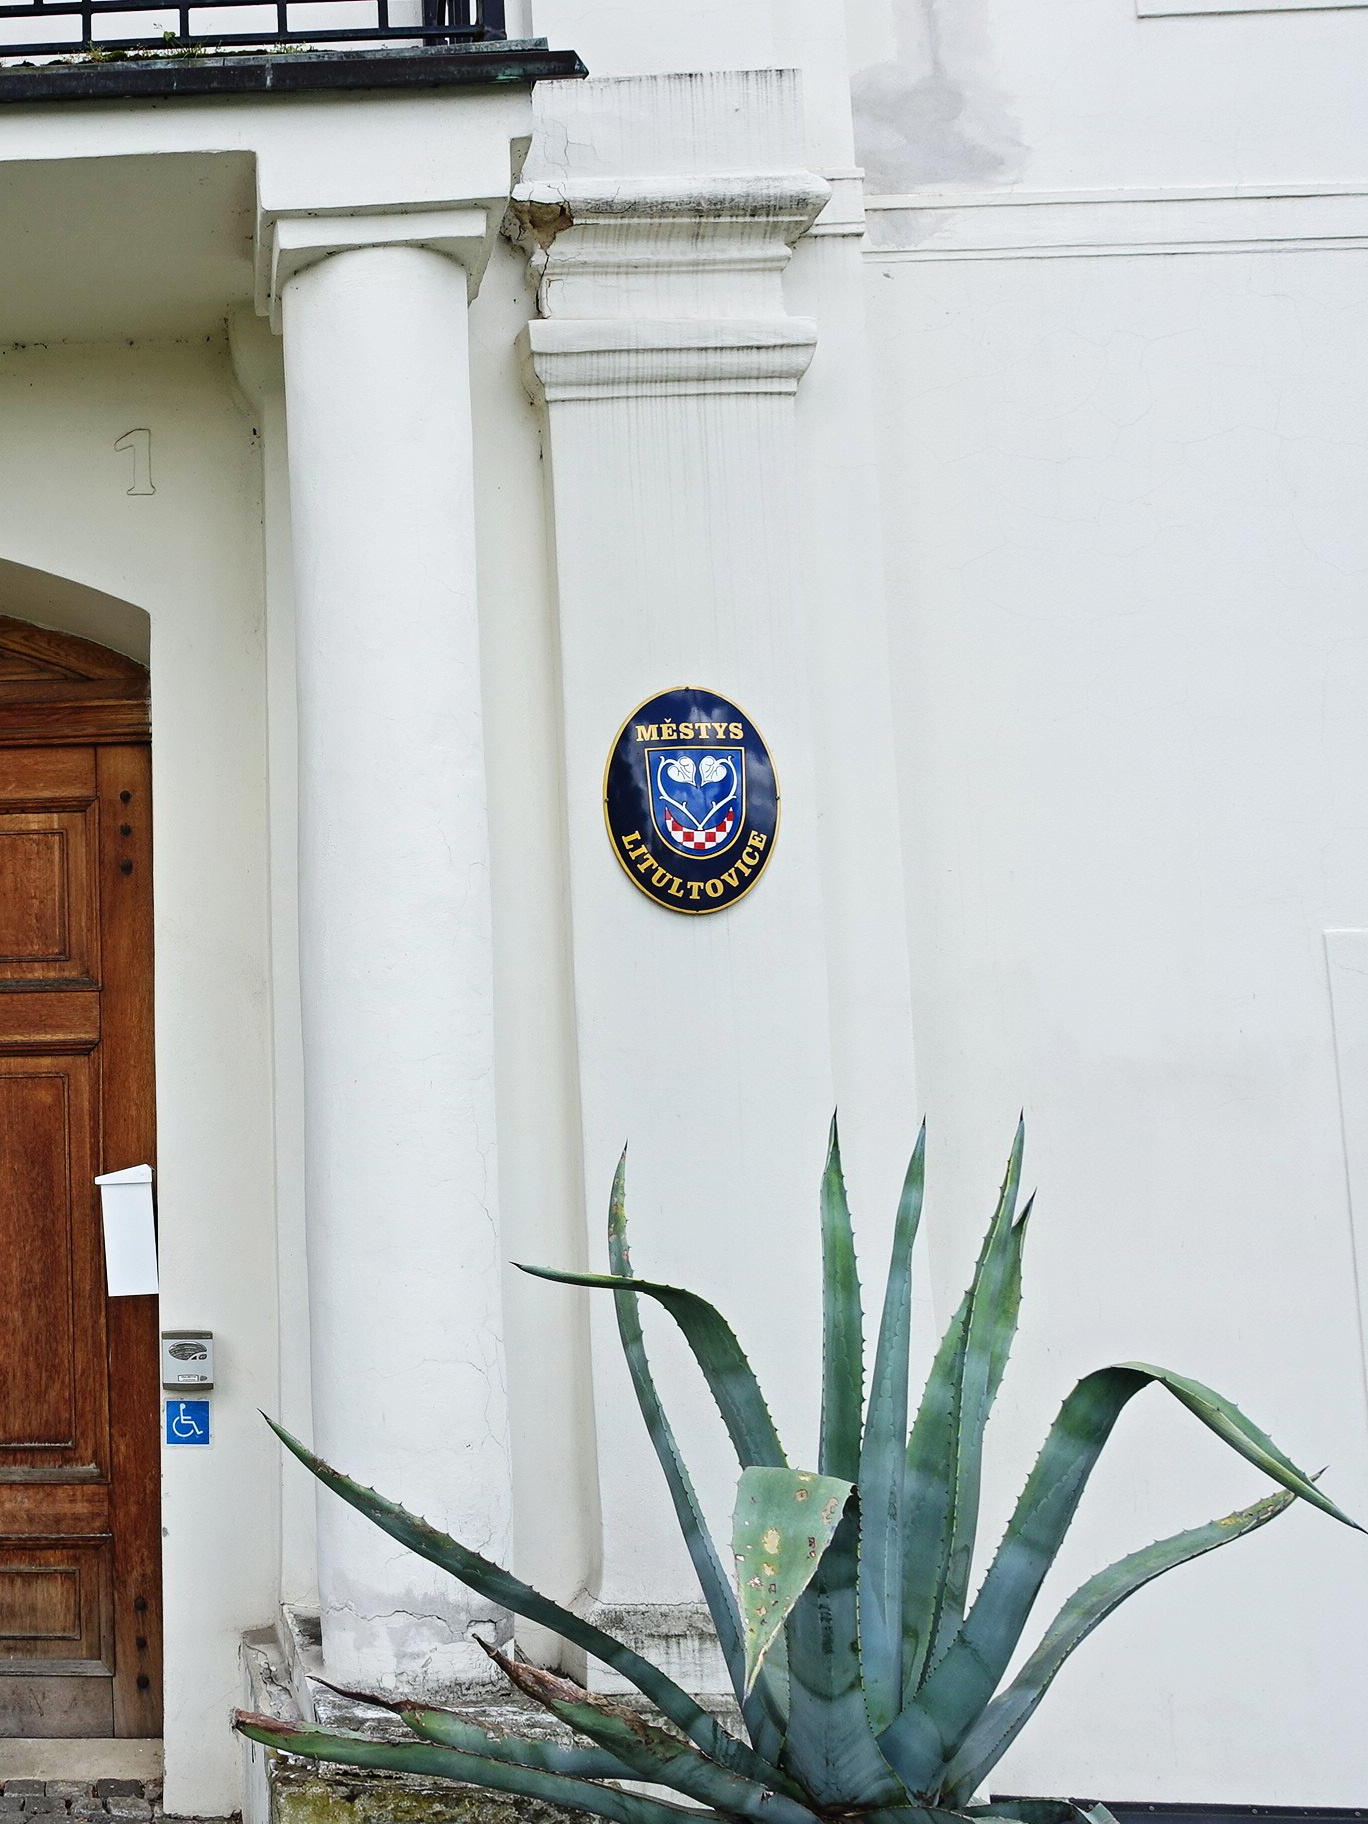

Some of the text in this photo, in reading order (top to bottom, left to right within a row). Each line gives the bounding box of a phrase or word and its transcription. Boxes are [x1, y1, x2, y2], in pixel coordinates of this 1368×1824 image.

[114, 428, 156, 496] 1
[635, 718, 744, 742] MĚSTYS
[621, 830, 768, 900] LITULTOVICE
